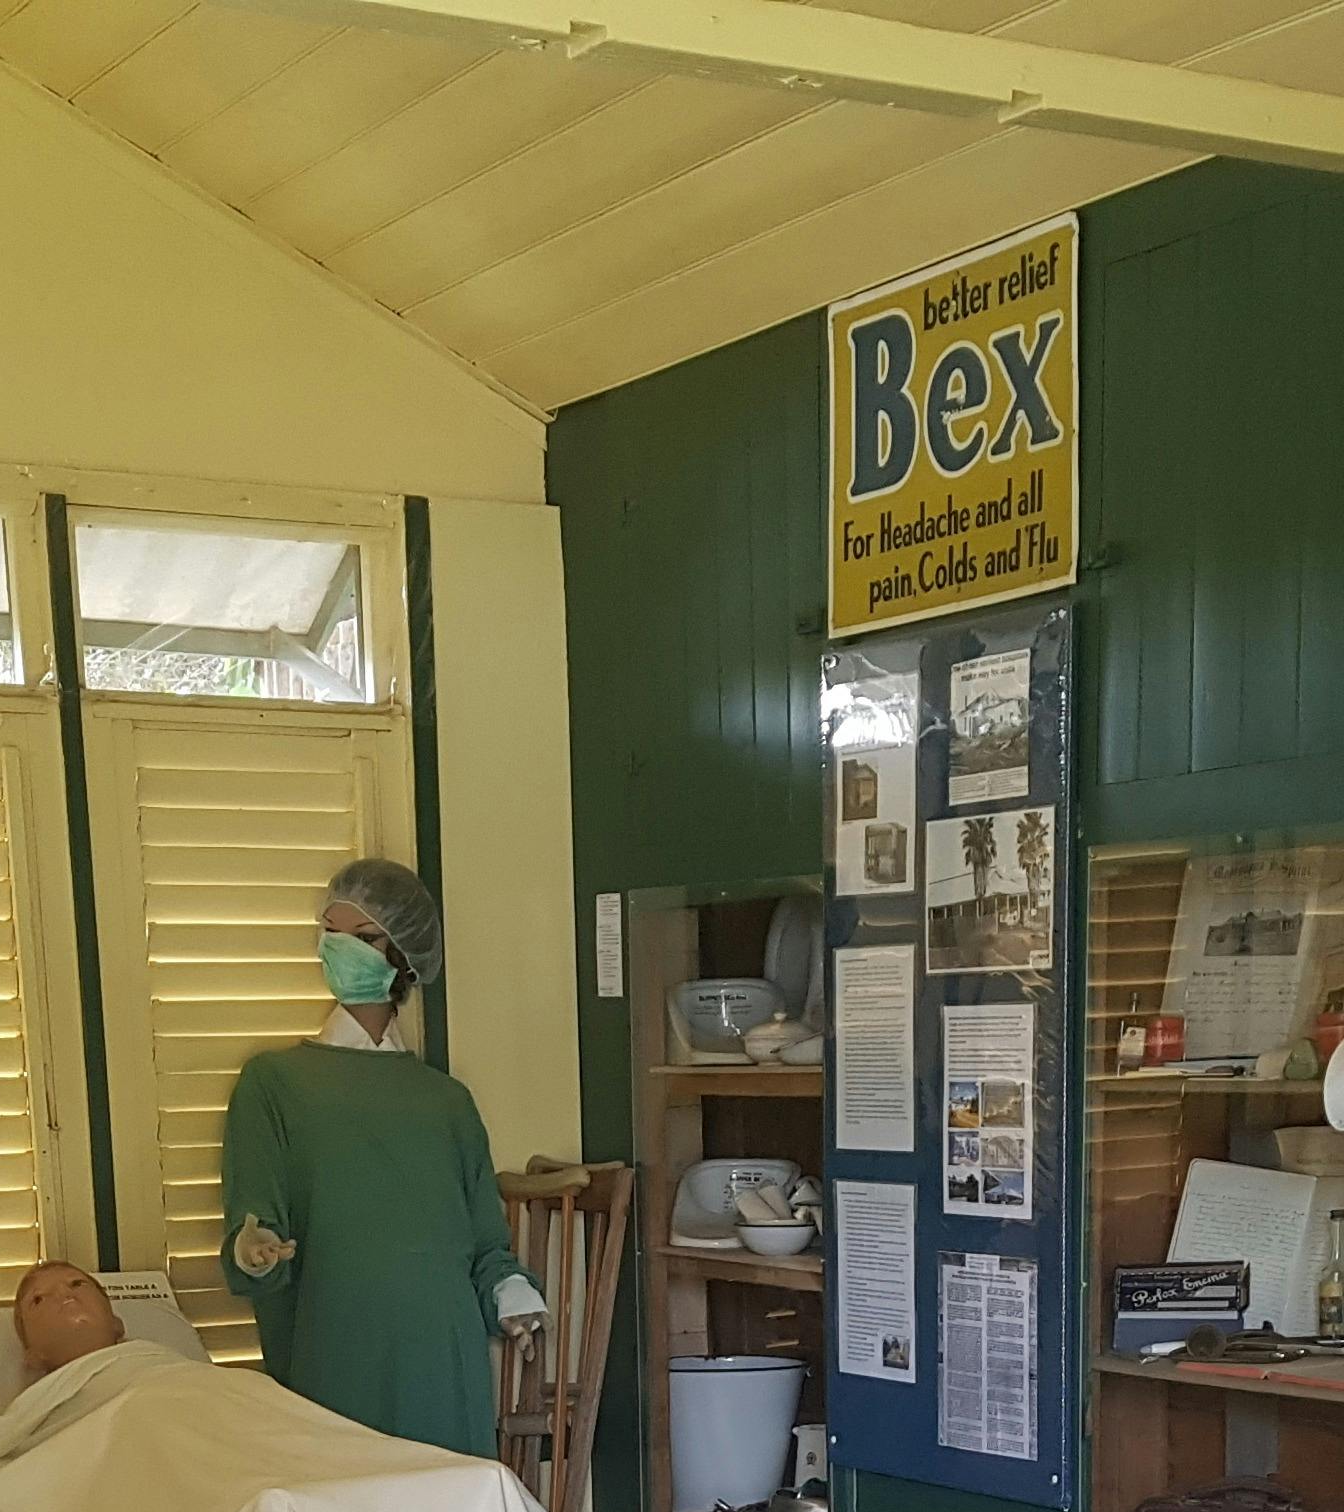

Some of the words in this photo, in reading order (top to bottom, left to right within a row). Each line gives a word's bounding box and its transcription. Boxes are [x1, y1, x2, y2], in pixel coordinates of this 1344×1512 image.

[923, 275, 992, 331] better
[998, 242, 1060, 305] relief
[848, 308, 1064, 502] Bex
[844, 520, 873, 562] For
[880, 494, 971, 553] Headache
[975, 477, 1012, 528] and
[1017, 468, 1044, 517] all
[869, 565, 917, 614] pain,
[918, 540, 978, 592] Colds
[984, 528, 1021, 578] and
